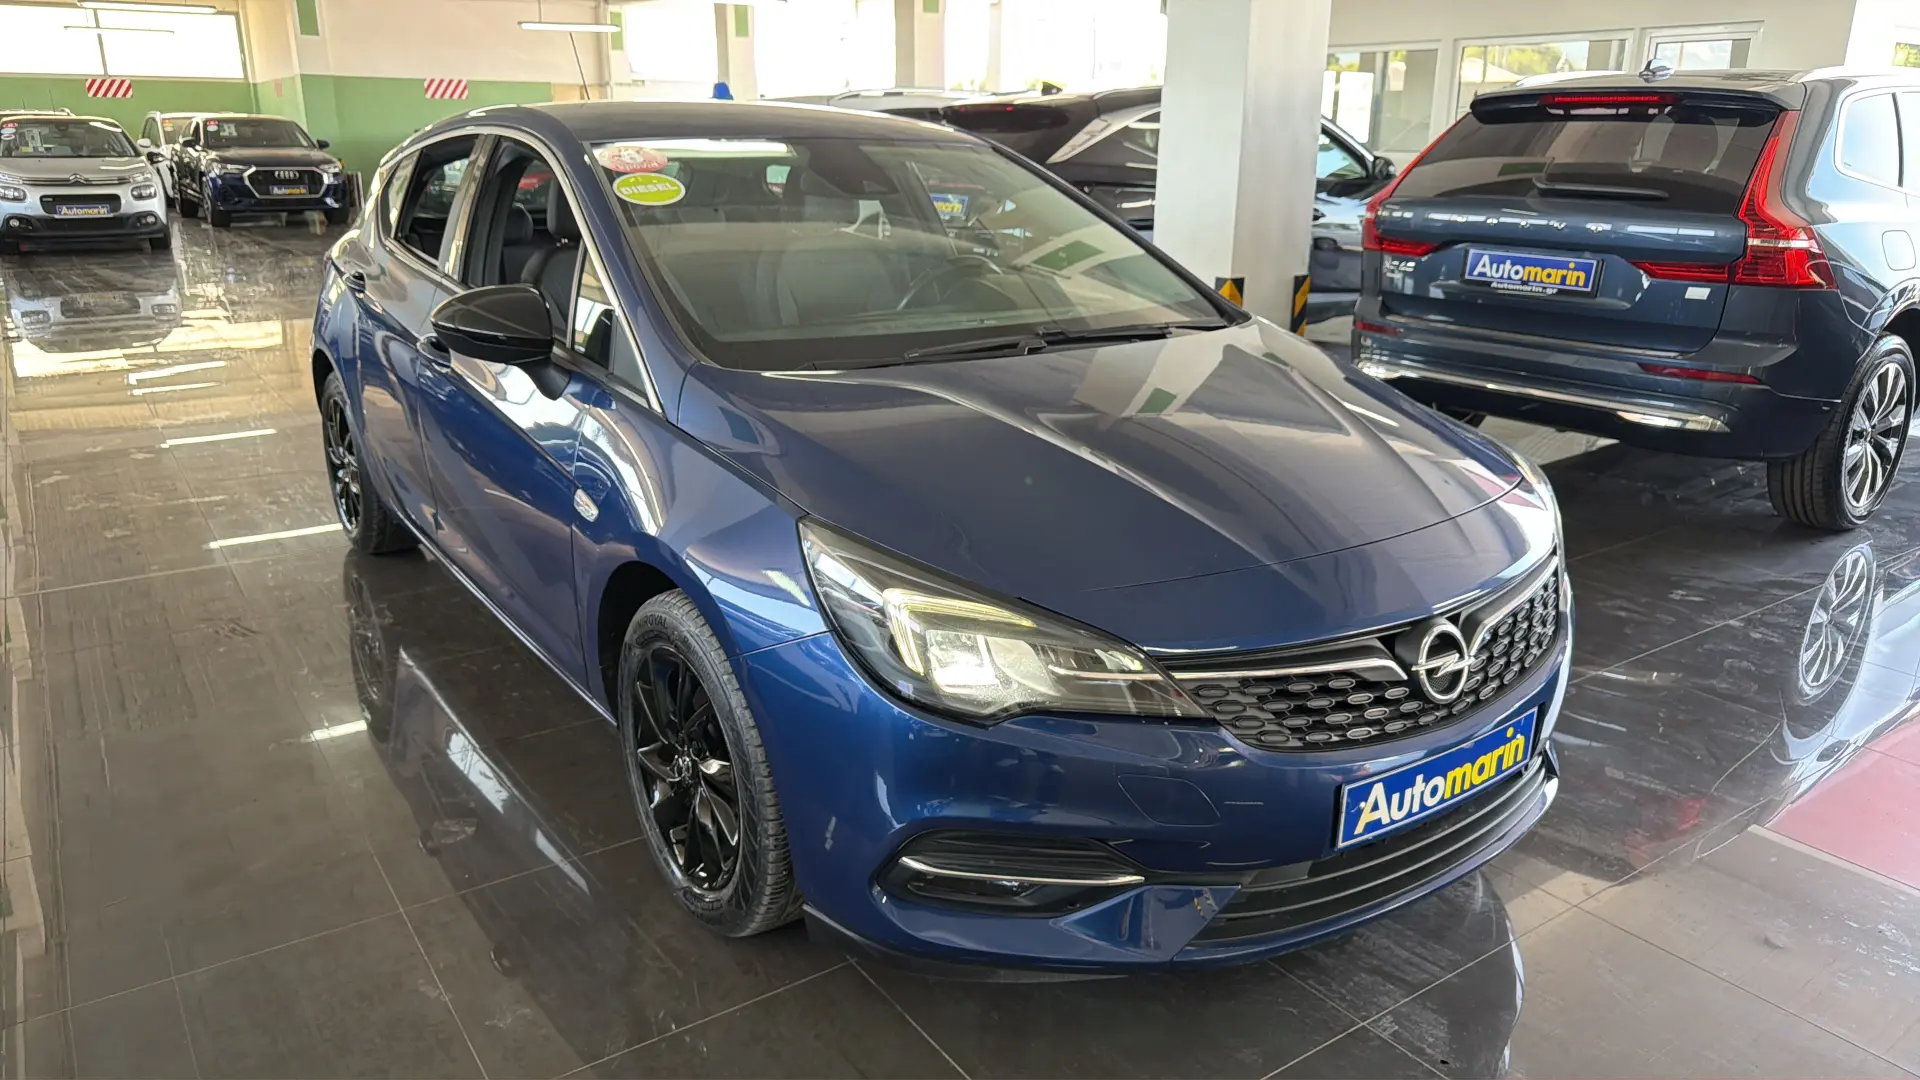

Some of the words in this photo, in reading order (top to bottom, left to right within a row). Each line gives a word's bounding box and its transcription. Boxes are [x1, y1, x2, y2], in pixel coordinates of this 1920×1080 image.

[619, 182, 678, 195] DIESEL
[61, 205, 108, 216] Automarin
[1472, 254, 1587, 287] Automarin
[1490, 281, 1559, 295] Automarin.gr
[1353, 726, 1526, 836] Automarin
